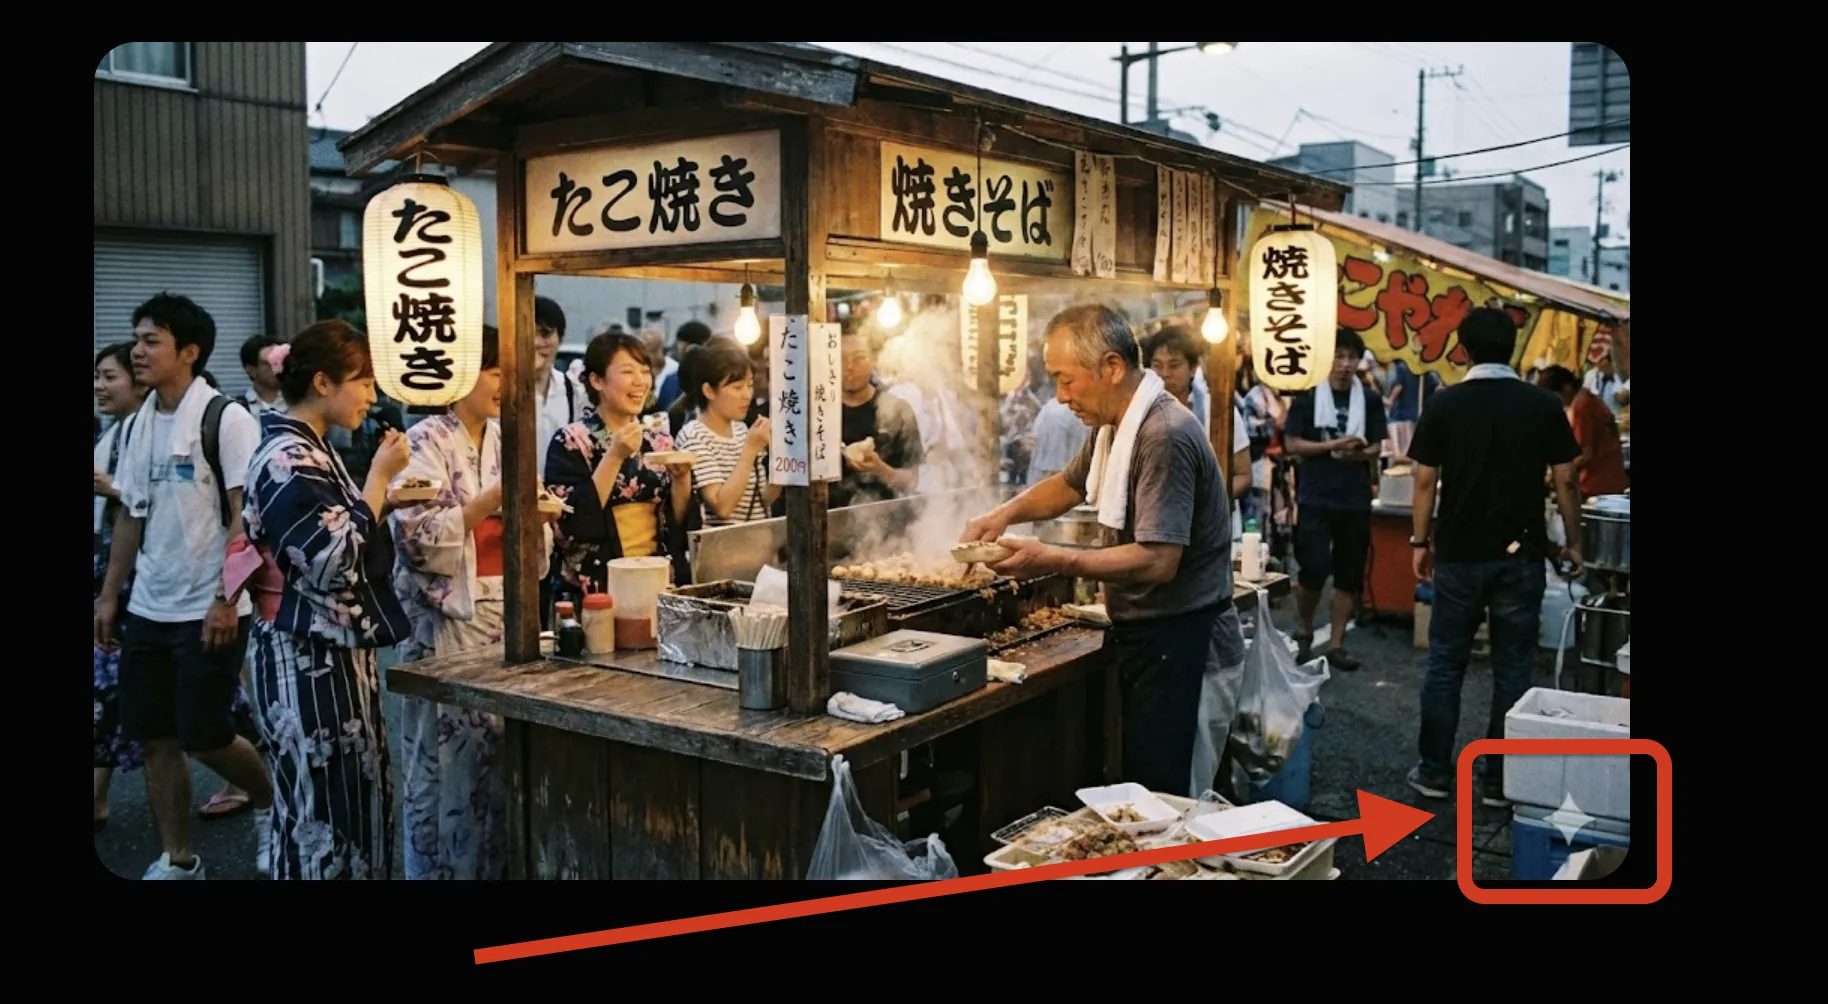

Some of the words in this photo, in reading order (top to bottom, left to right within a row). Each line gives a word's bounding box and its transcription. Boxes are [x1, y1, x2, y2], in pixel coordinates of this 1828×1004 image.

[551, 154, 755, 237] たこ焼き
[892, 154, 1054, 247] 焼きそば
[391, 198, 457, 391] たこ焼き
[1262, 245, 1311, 376] 焼きそば
[778, 326, 801, 446] たこ焼き
